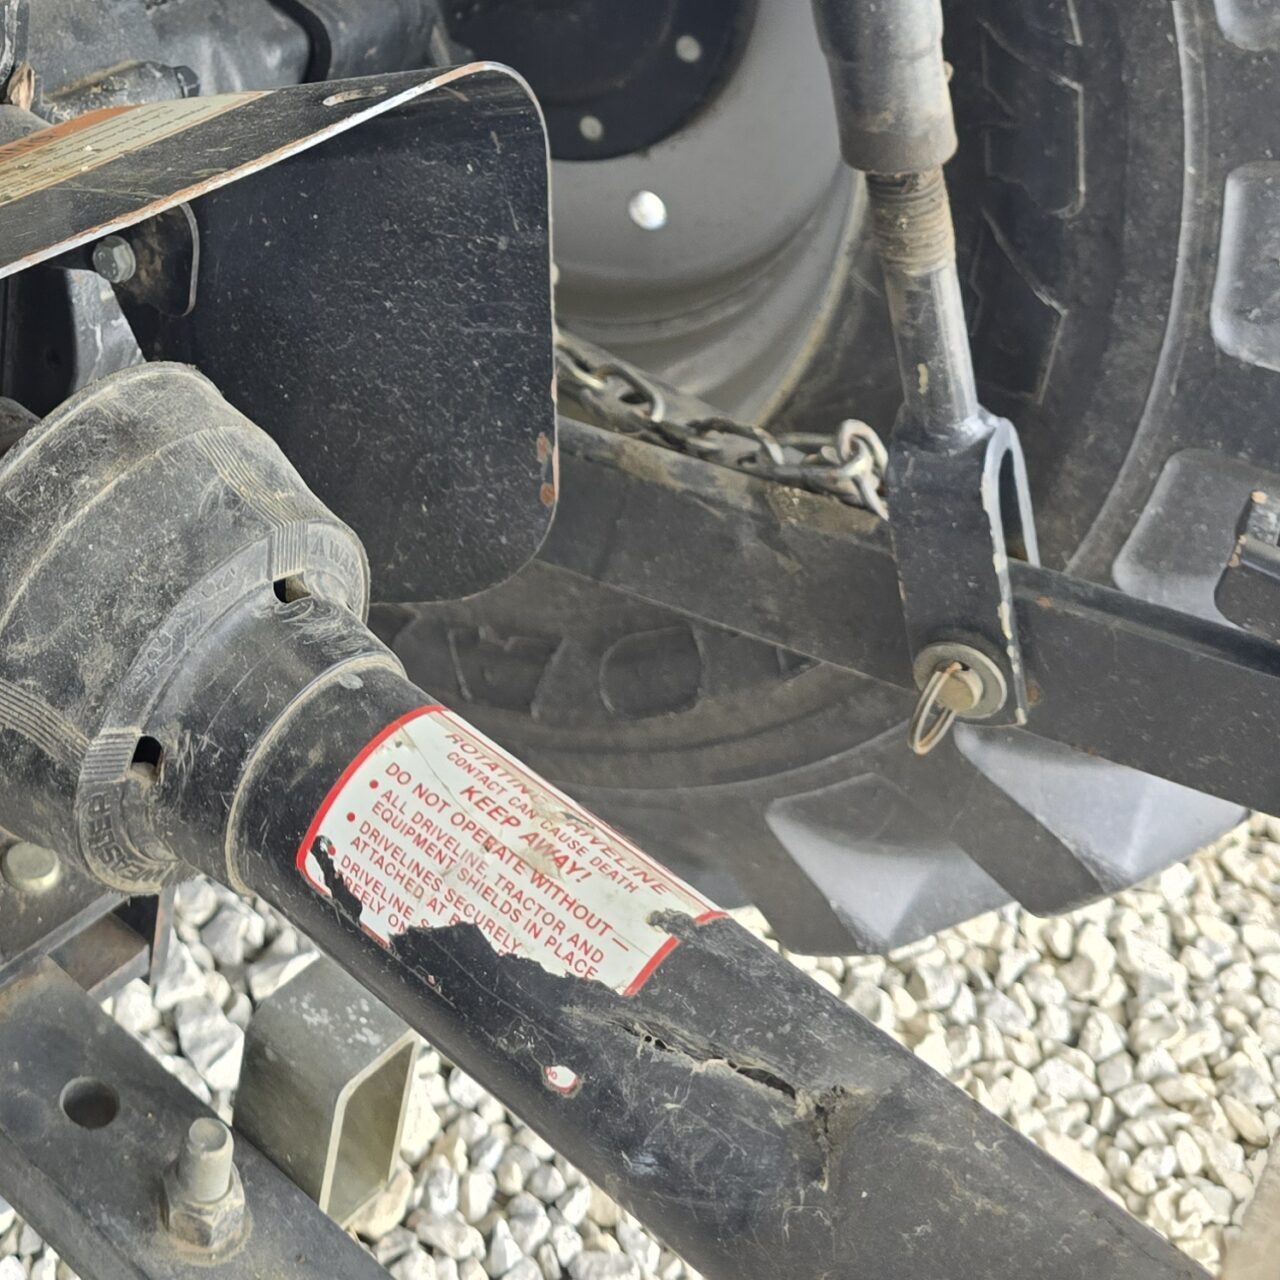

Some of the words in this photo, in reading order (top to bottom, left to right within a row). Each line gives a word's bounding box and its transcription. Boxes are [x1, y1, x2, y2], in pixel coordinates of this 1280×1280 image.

[340, 854, 415, 921] DRIVELINE
[350, 836, 425, 900] ATTACHED
[426, 897, 448, 916] AT
[359, 820, 443, 892] DRIVELINES
[444, 888, 522, 953] SECURELY
[381, 789, 408, 815] ALL
[410, 811, 489, 879] DRIVELINE,
[494, 873, 566, 936] TRACTOR
[567, 933, 604, 964] AND
[385, 762, 412, 785] DO
[412, 783, 451, 814] NOT
[450, 811, 527, 875] OPERATE
[530, 870, 613, 936] WITHOUT
[447, 752, 507, 795] CONTACT
[508, 796, 538, 820] CAN
[540, 819, 589, 857] CAUSE
[590, 856, 639, 893] DEATH
[460, 785, 521, 827] KEEP
[519, 831, 592, 883] AWAY!
[562, 816, 673, 895] RIVELINE
[371, 801, 457, 870] EQUIPMENT
[457, 867, 522, 924] SHIELDS
[523, 918, 544, 940] IN
[544, 935, 599, 979] PLACE
